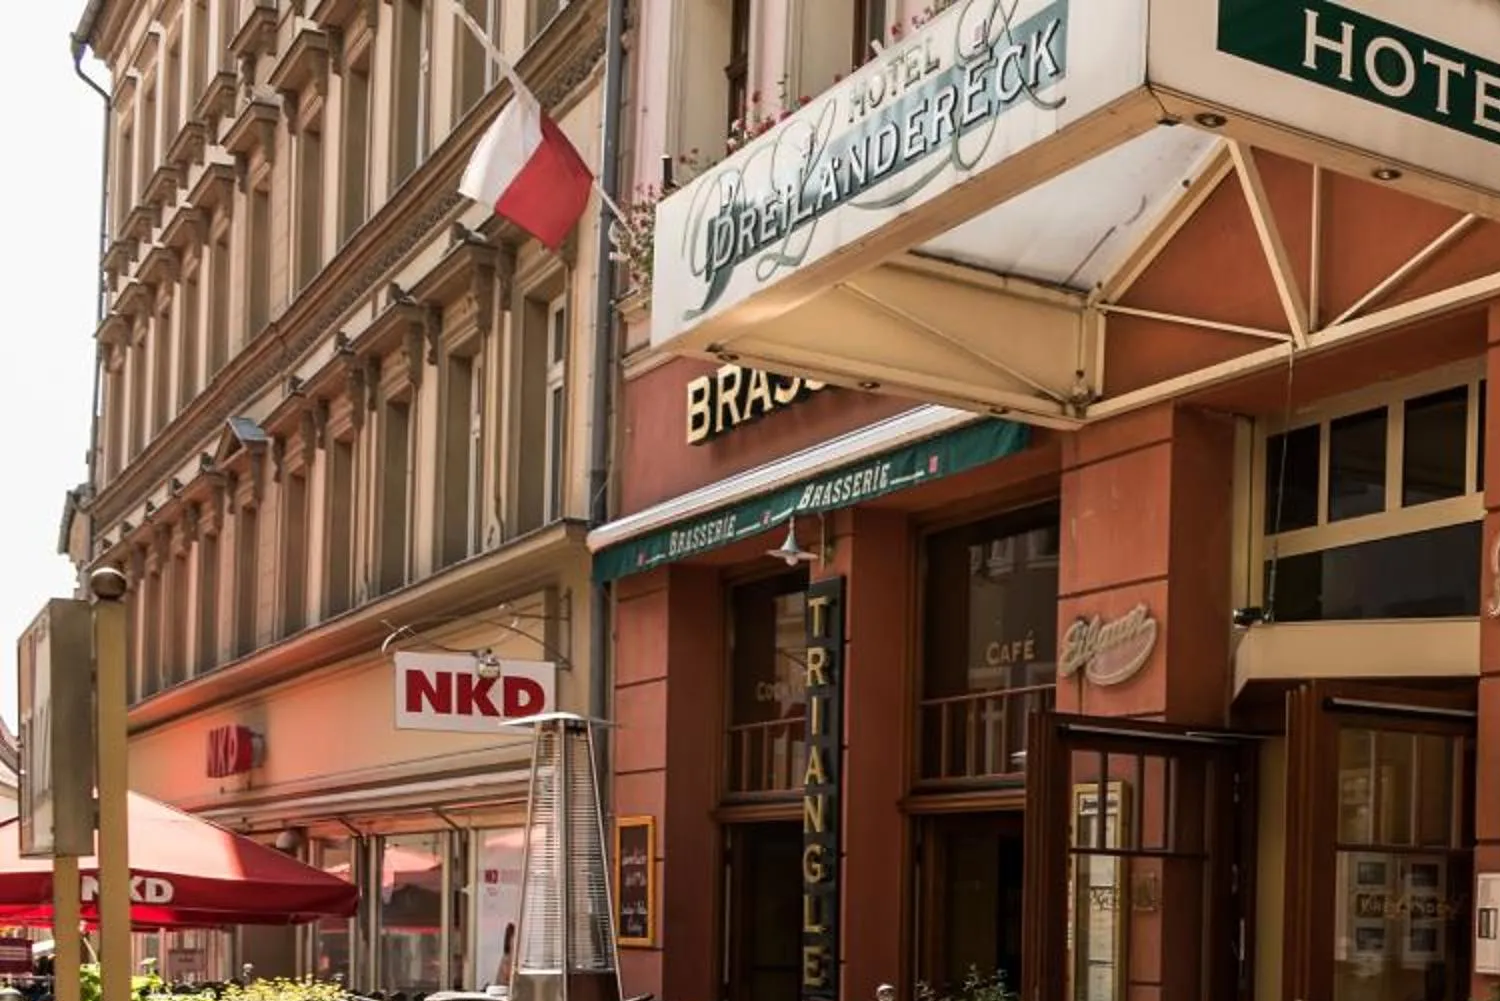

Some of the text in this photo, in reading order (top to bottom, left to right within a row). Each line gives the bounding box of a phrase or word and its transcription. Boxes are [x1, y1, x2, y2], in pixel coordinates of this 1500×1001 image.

[848, 33, 942, 124] HOTEL
[687, 363, 826, 444] BRA
[798, 460, 889, 511] BRASSERIE
[668, 513, 737, 555] BRASSERIE
[986, 629, 1036, 665] CAFÉ
[405, 669, 546, 718] NKD
[207, 728, 239, 777] NKD
[803, 596, 828, 987] TRIANGLE
